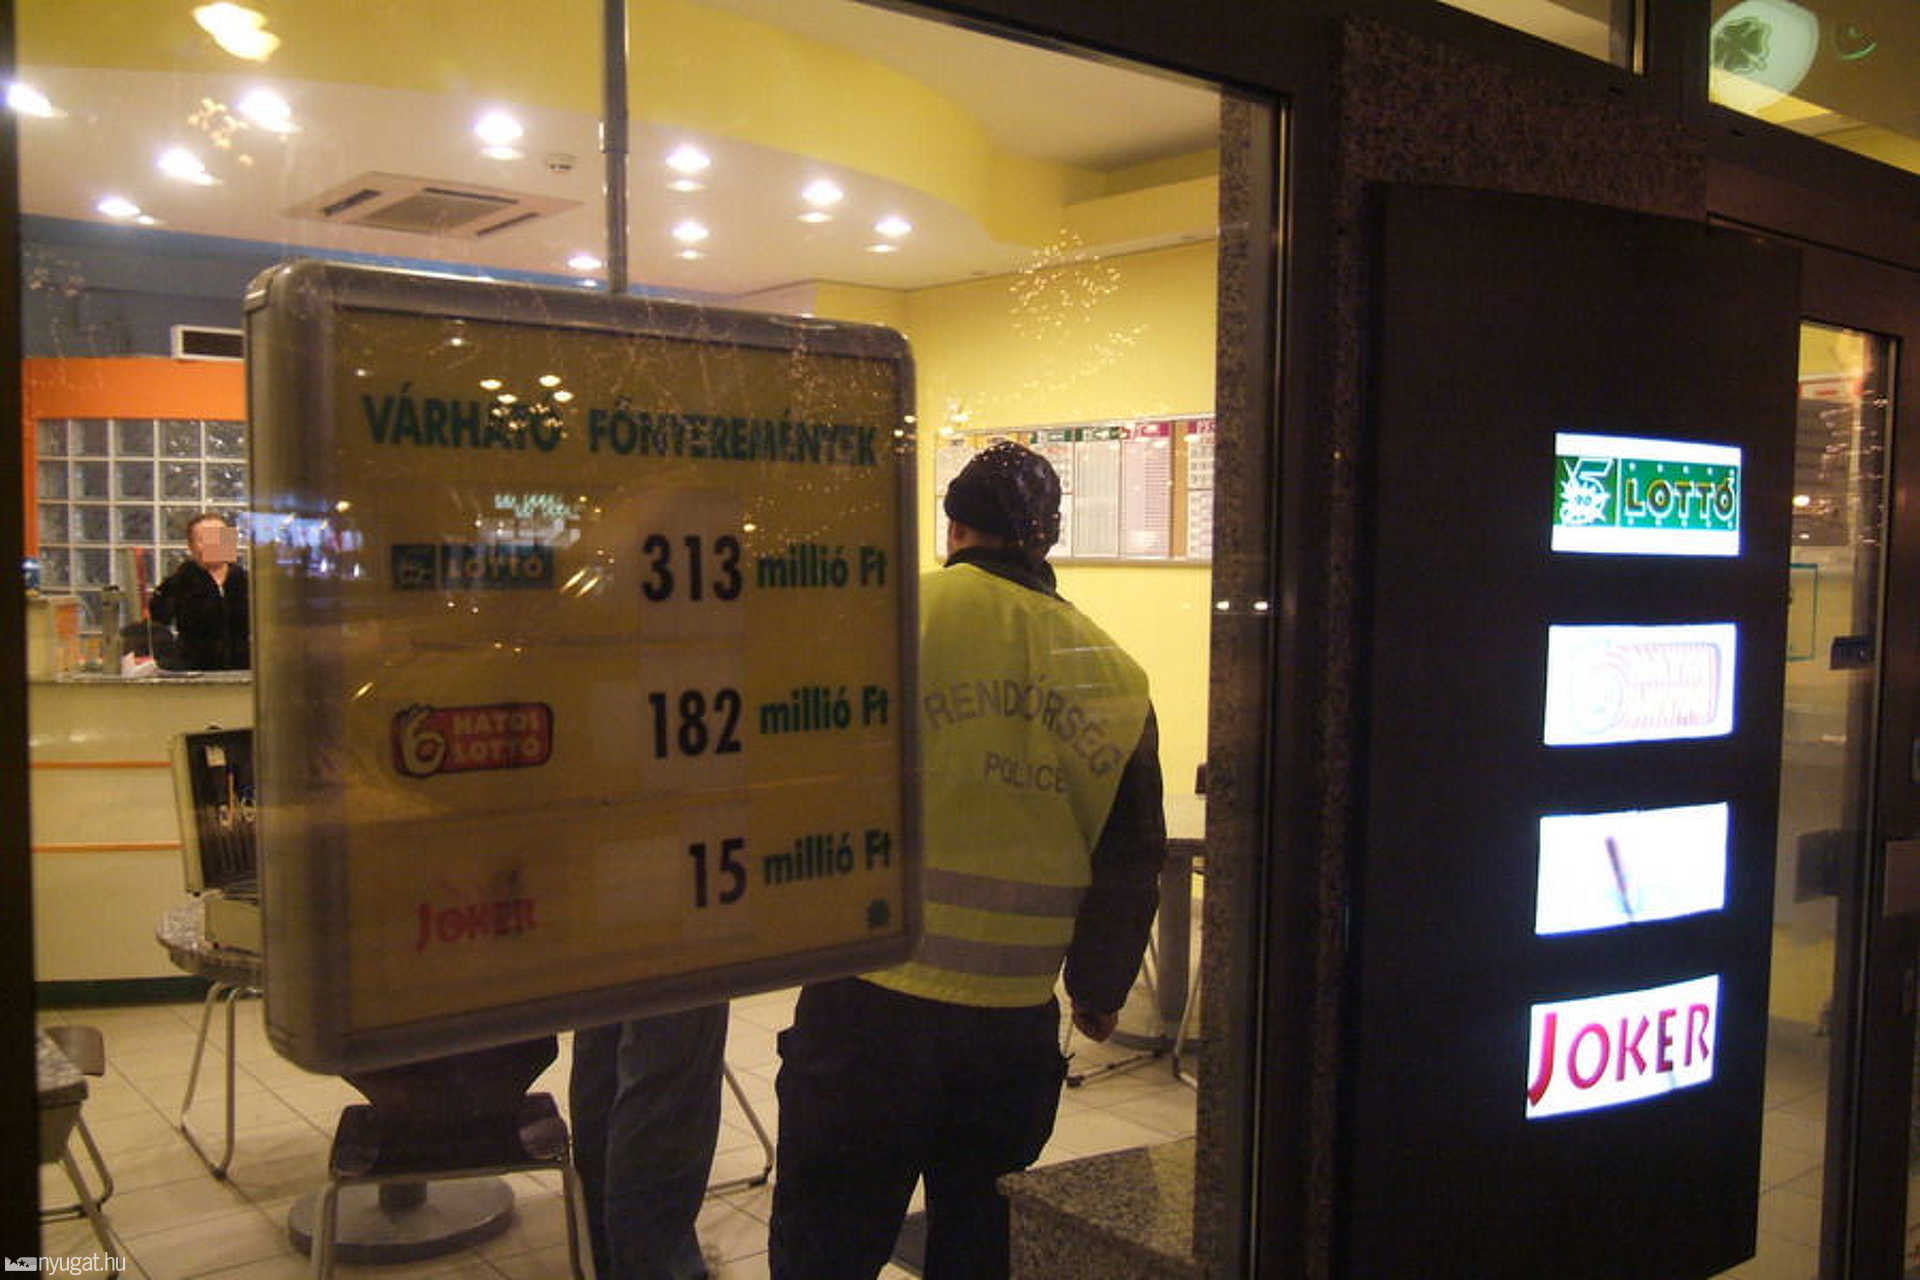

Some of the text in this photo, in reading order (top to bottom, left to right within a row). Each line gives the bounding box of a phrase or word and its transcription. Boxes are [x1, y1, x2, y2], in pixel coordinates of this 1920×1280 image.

[641, 534, 887, 602] 313 millió Ft
[648, 684, 888, 758] 182 millió Ft
[984, 749, 1068, 793] POLICE
[688, 829, 890, 908] 15 millió Ft
[1527, 1003, 1710, 1107] JOKER
